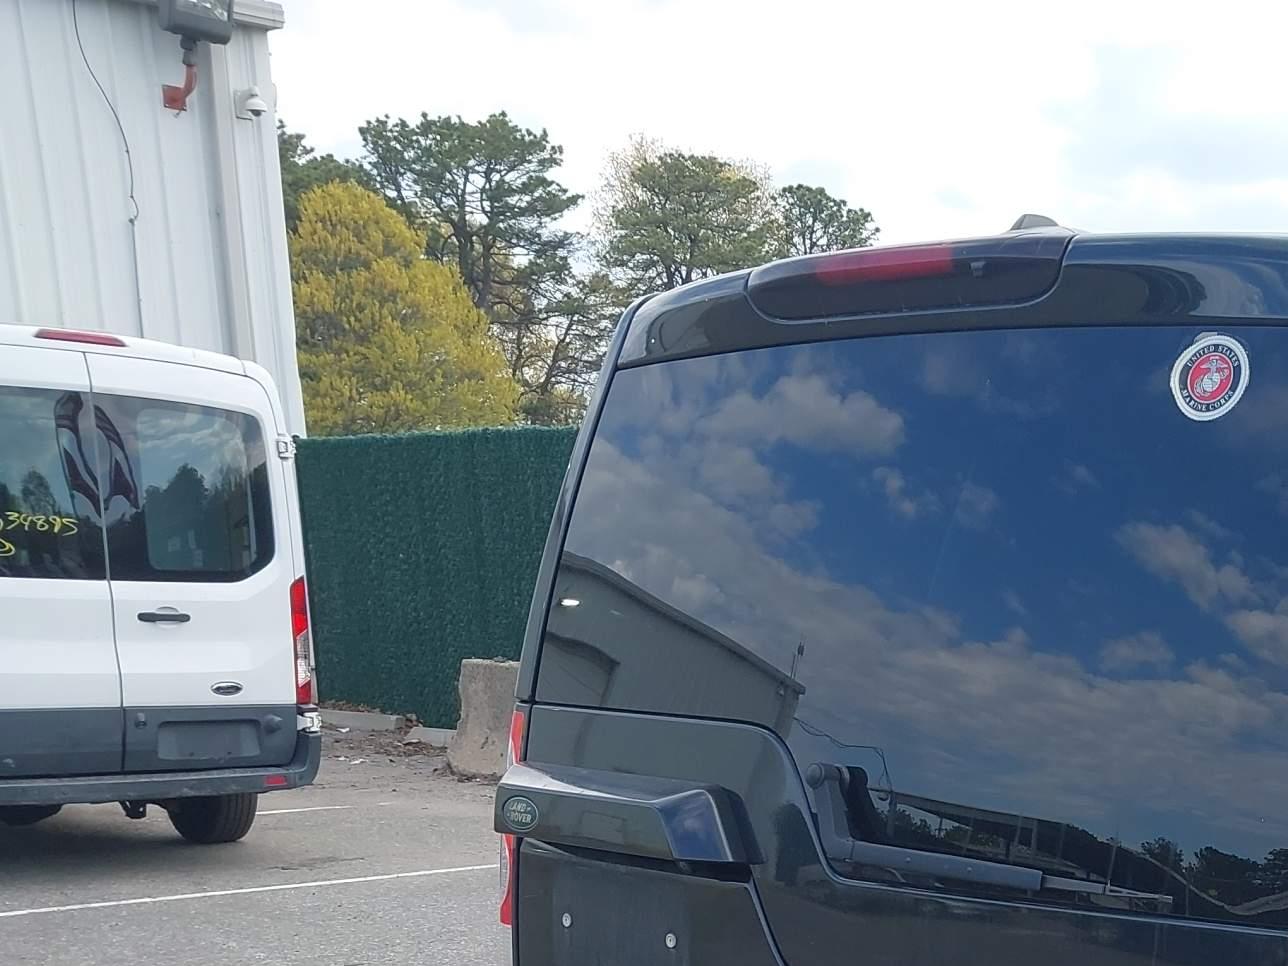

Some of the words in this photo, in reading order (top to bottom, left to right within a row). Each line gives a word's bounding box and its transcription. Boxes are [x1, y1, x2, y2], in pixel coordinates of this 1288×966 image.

[1187, 345, 1215, 367] UNITED
[1217, 345, 1240, 367] STATES
[1180, 389, 1207, 411] MARINE
[1209, 391, 1234, 410] CORPS
[511, 811, 532, 823] ROVER
